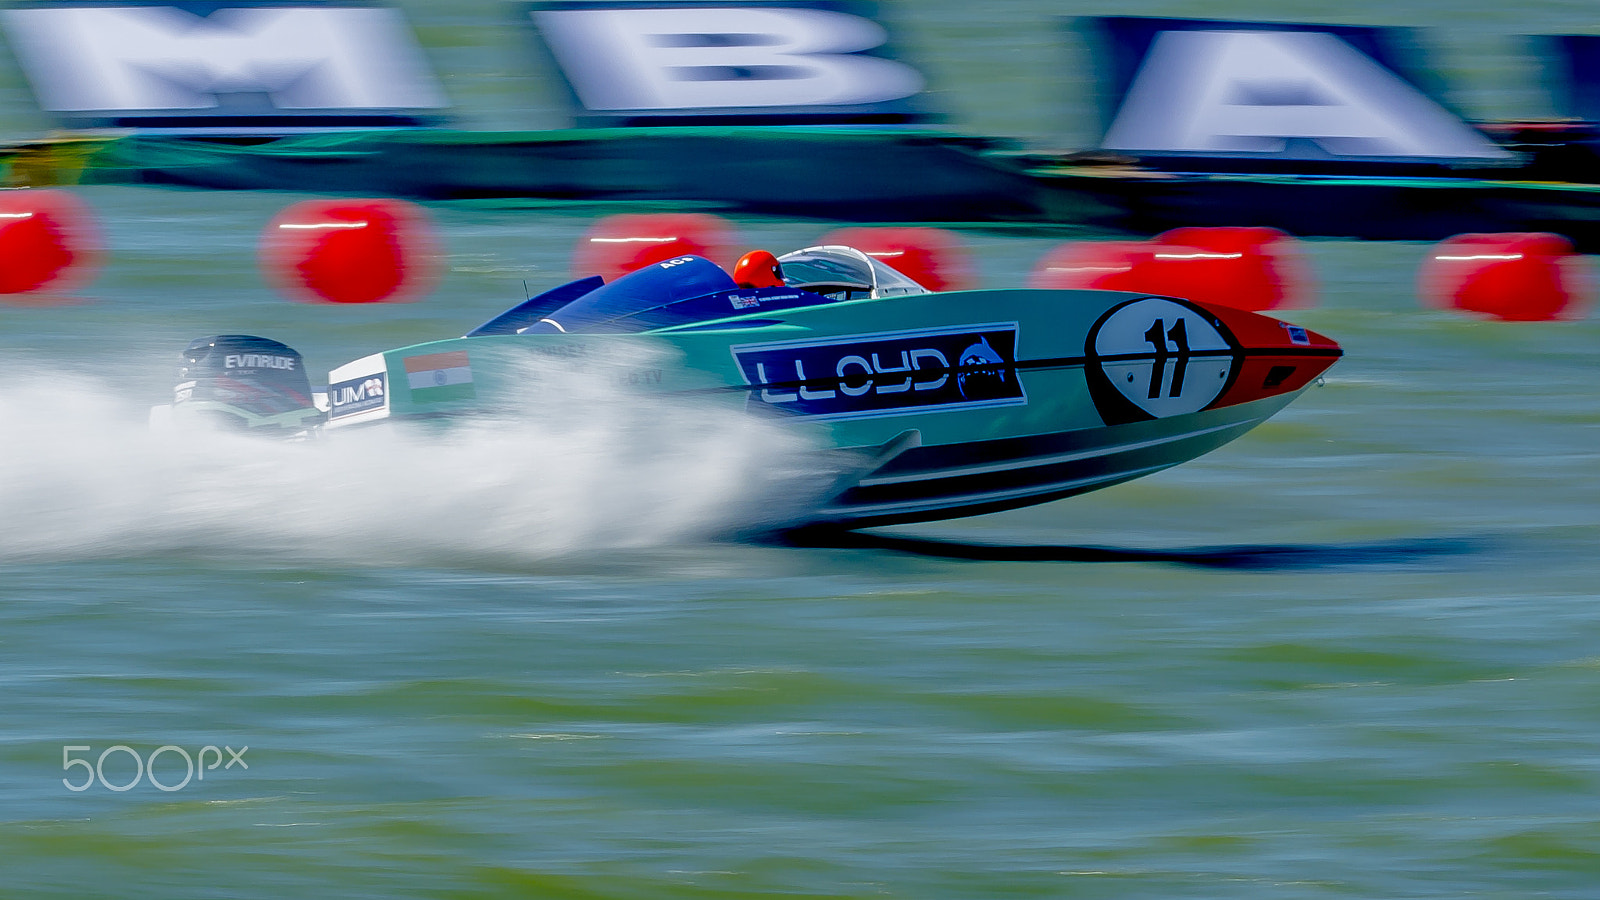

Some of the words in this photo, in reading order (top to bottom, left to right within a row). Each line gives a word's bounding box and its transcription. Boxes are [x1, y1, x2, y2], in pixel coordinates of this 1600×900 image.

[225, 354, 295, 371] EVINRUDE
[757, 349, 950, 403] LLOYD
[1144, 317, 1191, 399] 11
[333, 383, 365, 406] UIM
